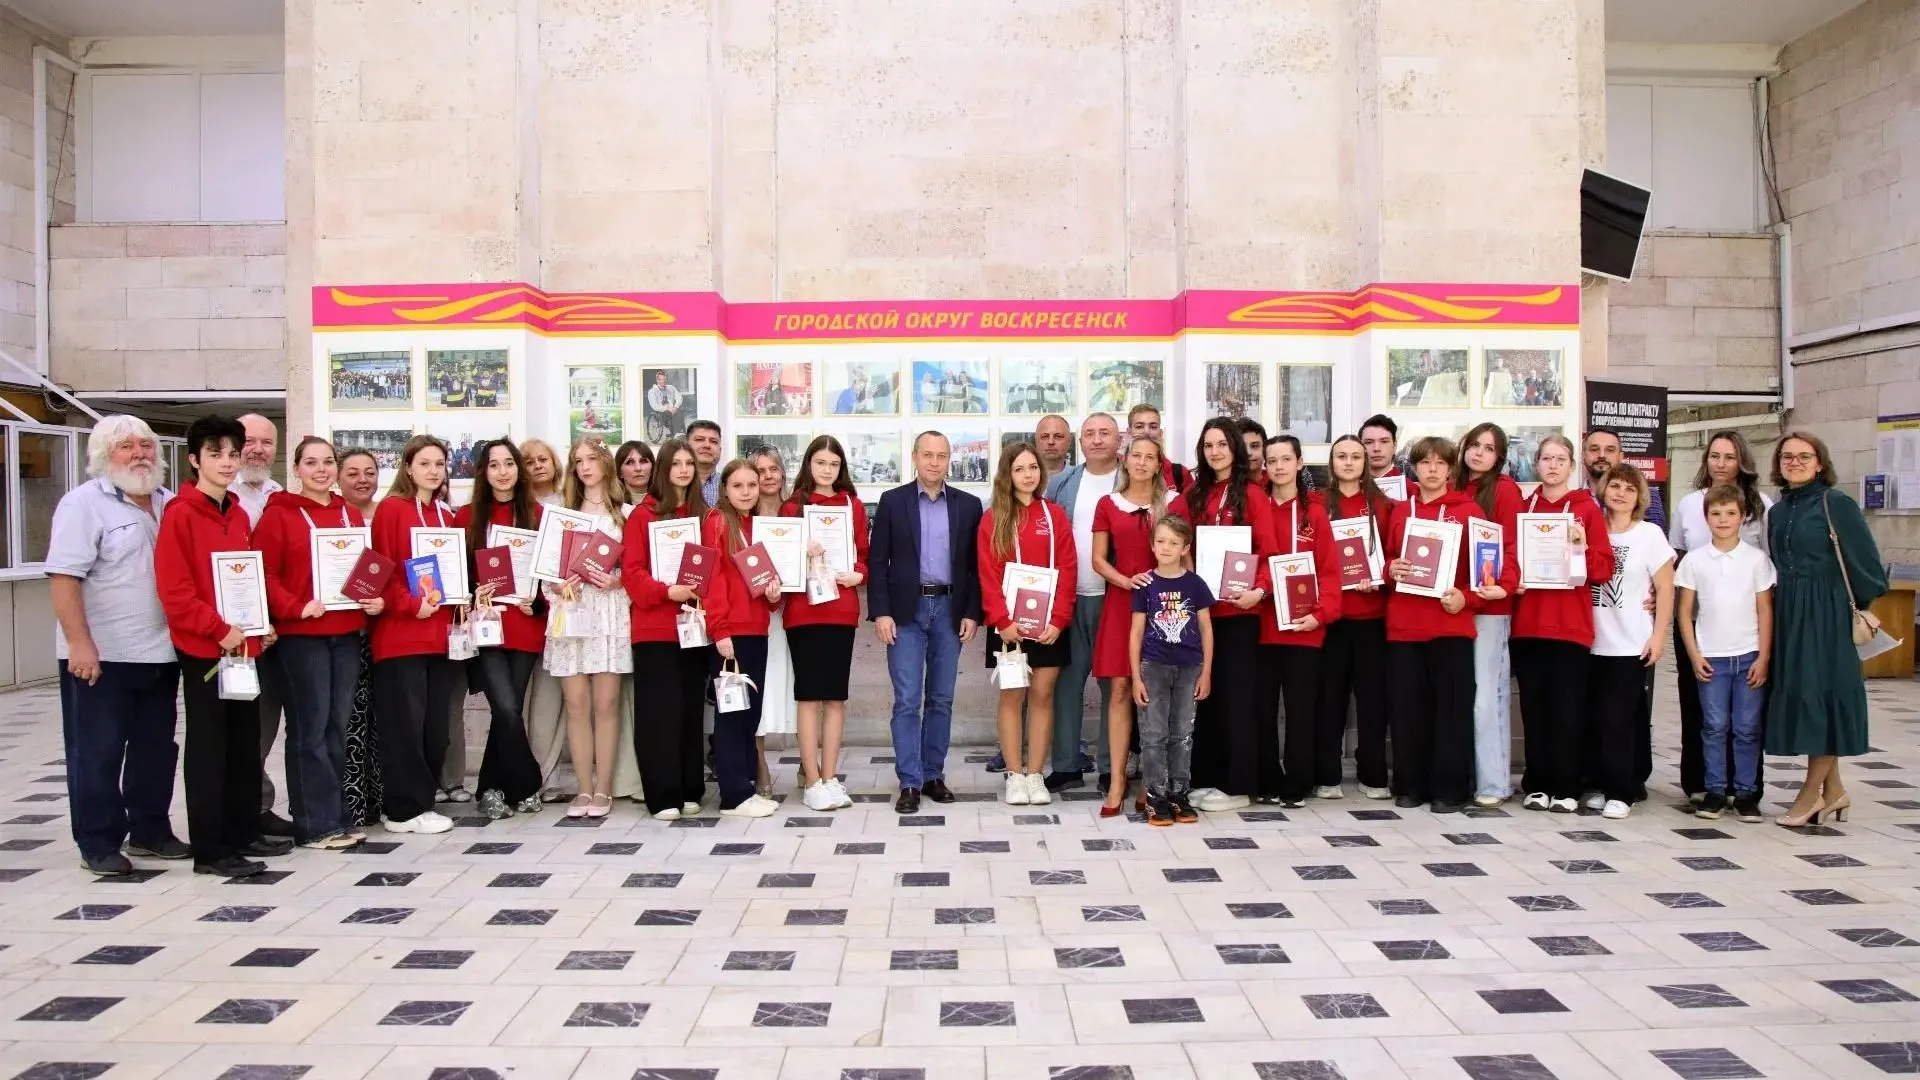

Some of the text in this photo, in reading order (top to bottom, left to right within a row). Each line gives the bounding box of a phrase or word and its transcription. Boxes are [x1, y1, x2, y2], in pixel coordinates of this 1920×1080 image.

[774, 309, 1129, 331] ГОРОДСКОЙ ОКРУГ ВОСКРЕСЕНСК
[1592, 401, 1660, 418] СЛУЖБА ПО КОНТРАКТУ
[1158, 591, 1181, 601] WIN
[1160, 600, 1181, 610] THE
[1154, 609, 1189, 619] GAME
